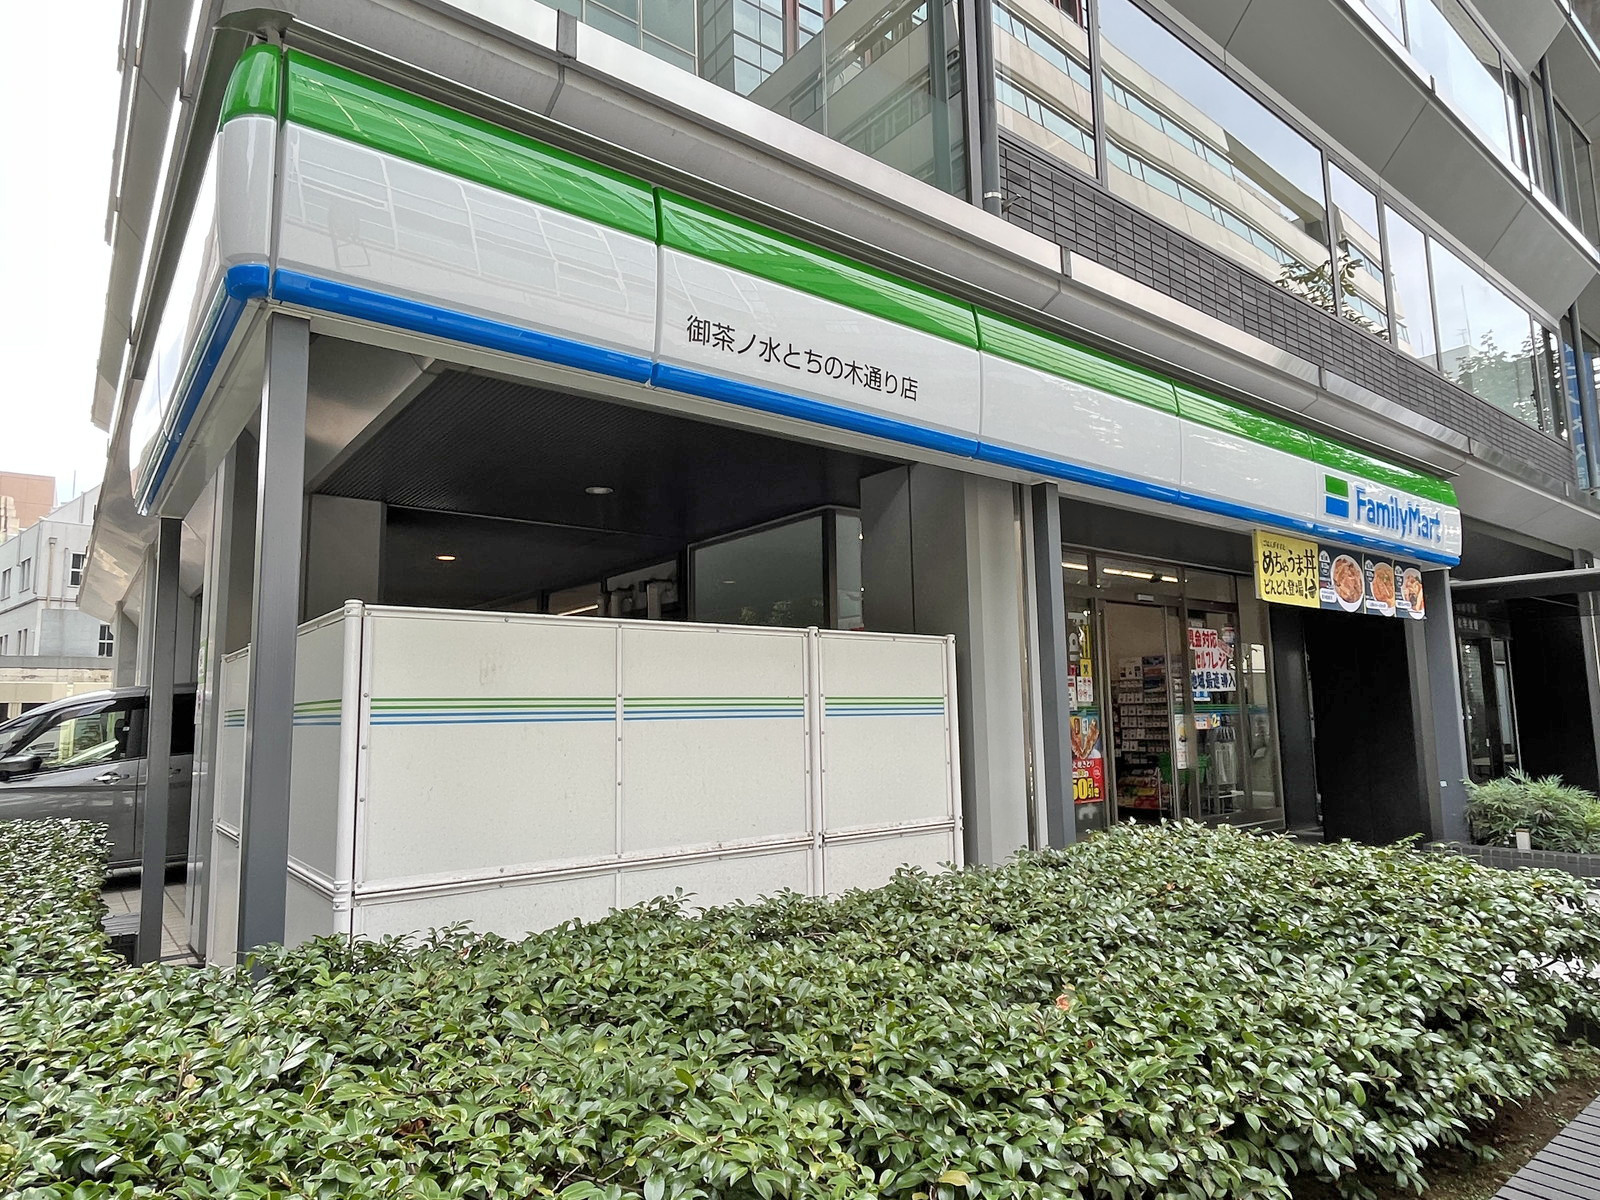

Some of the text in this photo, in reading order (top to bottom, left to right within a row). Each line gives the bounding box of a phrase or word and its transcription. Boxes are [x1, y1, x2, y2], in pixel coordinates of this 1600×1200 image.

[686, 314, 918, 402] 御茶ノ水とちの木通り店
[1355, 485, 1441, 543] FamilyMart
[1262, 548, 1317, 579] めちゃうま丼
